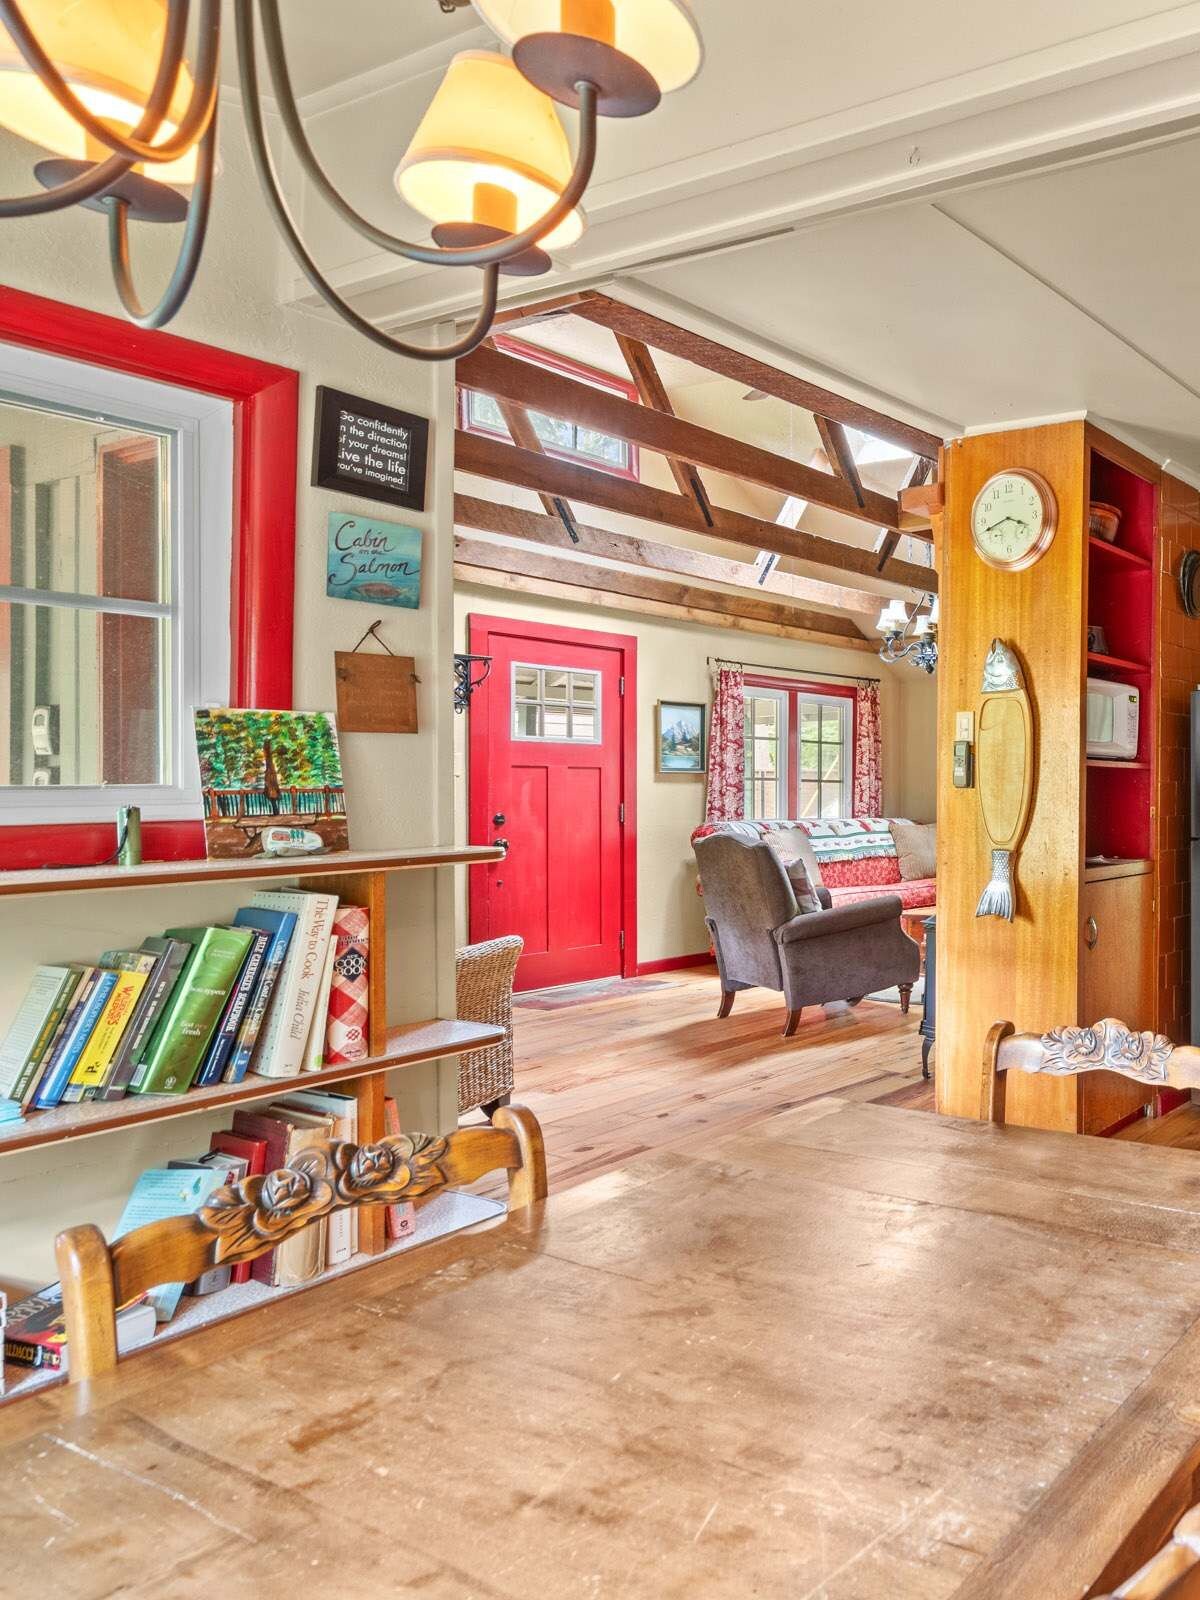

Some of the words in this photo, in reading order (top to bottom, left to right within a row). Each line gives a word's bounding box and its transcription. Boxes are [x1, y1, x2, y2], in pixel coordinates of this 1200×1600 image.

[350, 426, 364, 437] the
[368, 430, 408, 450] direction
[358, 418, 408, 440] confidently
[348, 440, 369, 450] your
[372, 444, 407, 461] dreams!
[364, 454, 384, 469] the
[388, 459, 406, 474] life
[366, 468, 406, 486] imagined.
[335, 520, 397, 552] Cabin
[328, 552, 420, 586] Salmon
[316, 898, 329, 919] The
[308, 917, 325, 939] Way
[302, 952, 319, 980] Cook
